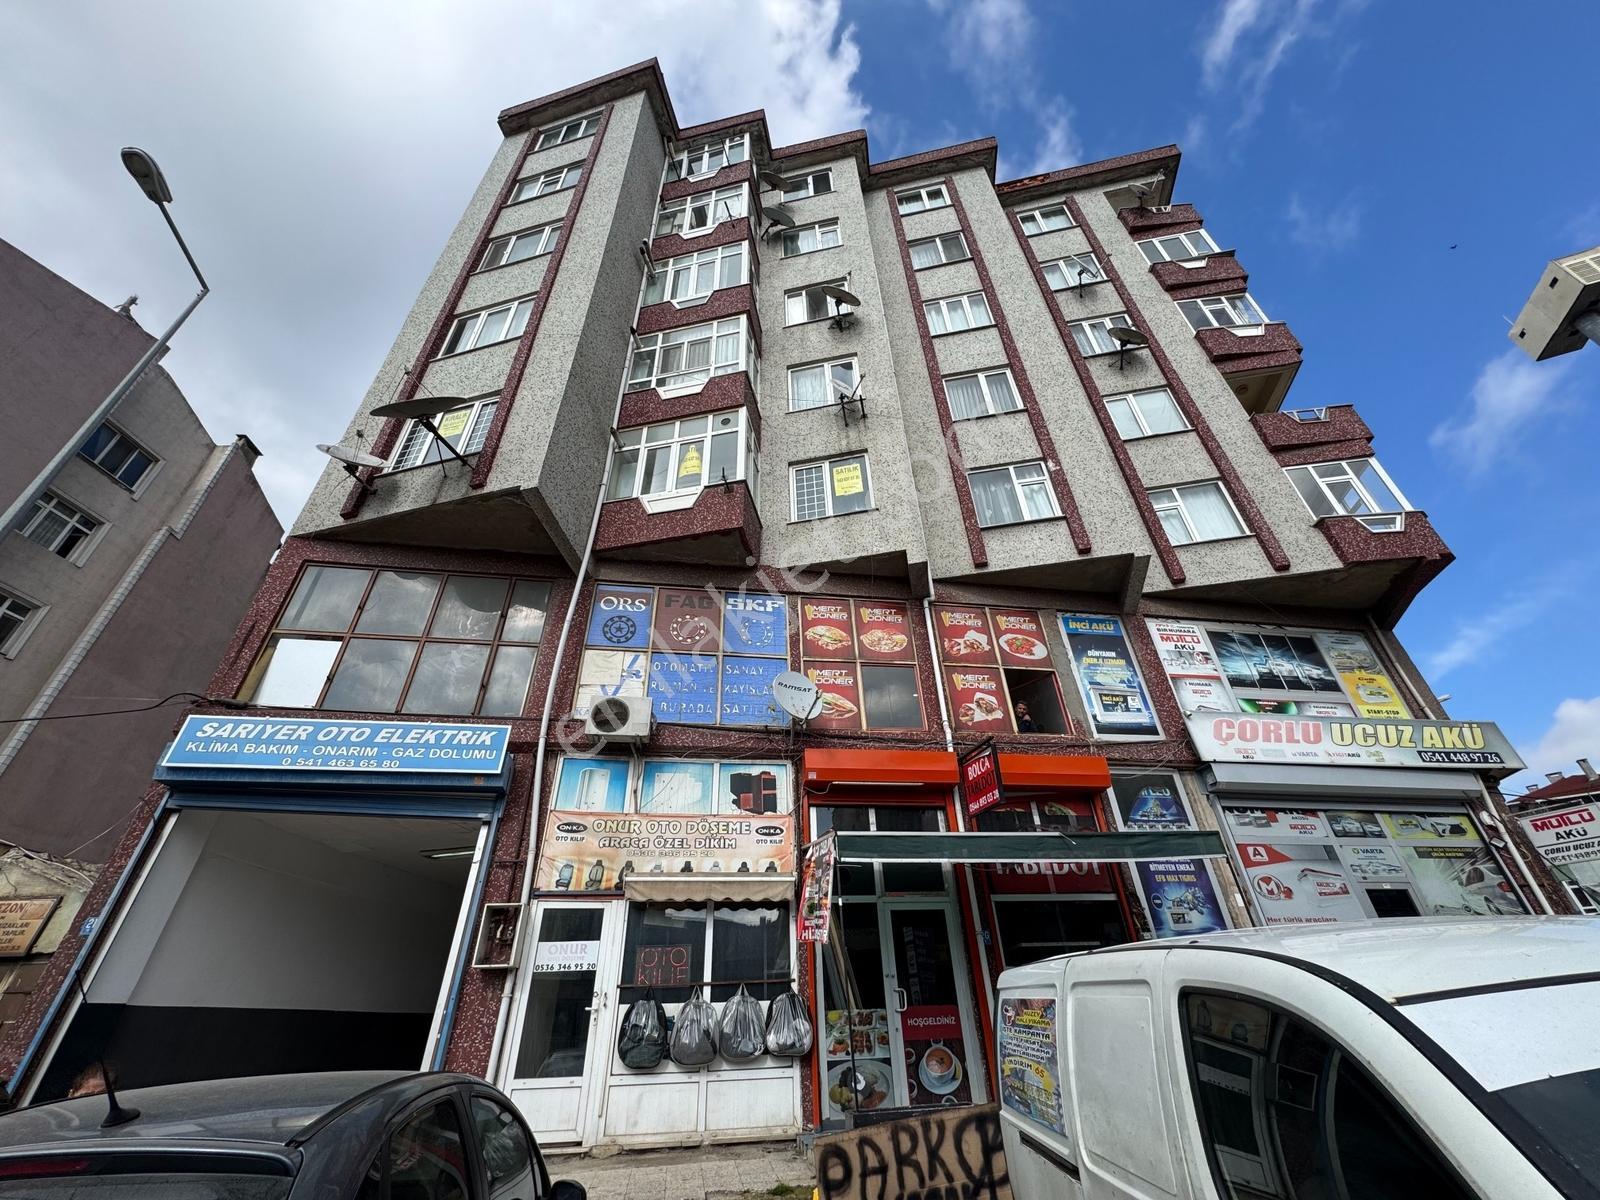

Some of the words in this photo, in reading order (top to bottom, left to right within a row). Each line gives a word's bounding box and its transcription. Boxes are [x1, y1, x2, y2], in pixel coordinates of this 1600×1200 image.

[600, 596, 647, 612] ORS
[726, 597, 785, 612] SKF
[868, 608, 897, 616] MERT
[1004, 615, 1030, 624] MERT
[1159, 633, 1201, 644] MUTLU
[960, 673, 990, 681] MERT
[778, 681, 812, 694] RAMSAT
[196, 722, 314, 740] SARIYER
[317, 726, 370, 742] OTO
[1213, 717, 1322, 747] ÇORLU
[1330, 722, 1417, 748] UCUZ
[1422, 723, 1486, 750] AKÜ
[185, 740, 239, 753] KLİMA
[243, 742, 299, 755] BAKIM
[312, 745, 378, 757] ONARIM
[392, 747, 425, 759] GAZ
[429, 748, 497, 760] DOLUMU
[282, 757, 290, 766] 0
[296, 758, 323, 766] 541
[328, 758, 354, 767] 463
[359, 759, 377, 768] 65
[382, 760, 400, 768] 80
[1421, 751, 1450, 762] 0541
[1450, 752, 1469, 763] 448
[1470, 753, 1484, 763] 97
[1486, 754, 1500, 764] 26
[968, 755, 990, 781] BOLCA
[1529, 808, 1595, 832] MUTLU
[592, 819, 643, 835] ONUR
[646, 820, 684, 835] OTO
[686, 818, 751, 838] DÖŞEME
[1555, 827, 1588, 841] AKÜ
[570, 835, 586, 843] KILIF
[598, 836, 650, 849] ARACA
[653, 835, 692, 849] ÖZEL
[694, 834, 737, 849] DİKİM
[1544, 845, 1571, 856] ÇORLU
[1573, 841, 1596, 851] UCUZ
[548, 943, 588, 955] ONUR
[640, 946, 687, 967] OTO
[535, 964, 554, 972] 0536
[557, 963, 572, 971] 346
[587, 962, 596, 970] 20
[908, 1015, 957, 1027] HOŞGELDİNİZ
[1034, 1067, 1045, 1078] 65
